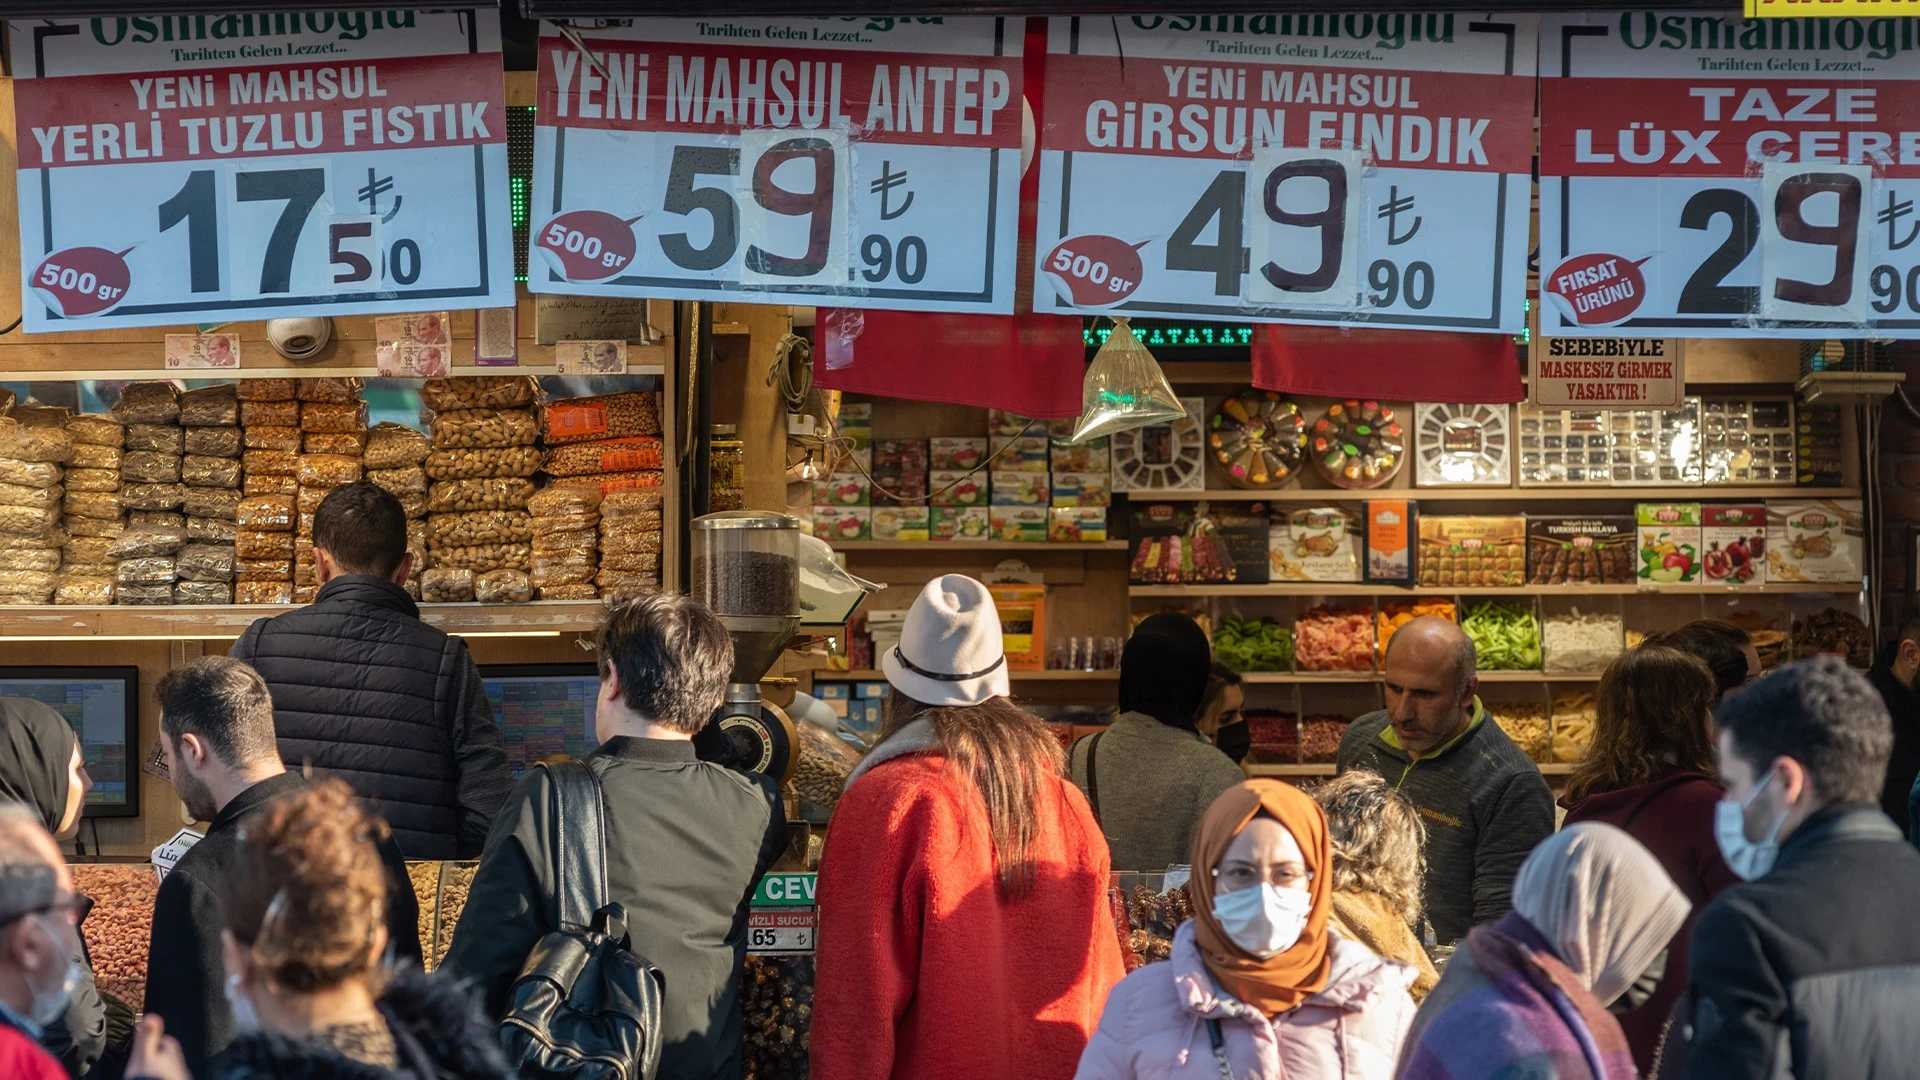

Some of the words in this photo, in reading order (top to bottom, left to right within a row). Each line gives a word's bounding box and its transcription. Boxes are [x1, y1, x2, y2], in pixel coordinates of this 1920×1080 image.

[696, 23, 760, 38] Tarihten
[764, 25, 807, 40] Gelen
[812, 28, 872, 43] Lezzet...
[1206, 39, 1272, 56] Tarihten
[1275, 43, 1320, 58] Gelen
[1323, 46, 1383, 61] Lezzet...
[1619, 11, 1920, 59] Osmanlıoğl
[171, 46, 236, 62] Tarihten
[239, 44, 284, 59] Gelen
[286, 41, 347, 56] Lezzet...
[1698, 57, 1762, 71] Tarihten
[1767, 57, 1809, 71] Gelen
[1814, 58, 1875, 72] Lezzet...
[229, 66, 386, 105] MAHSUL
[666, 56, 850, 129] MAHSUL
[868, 64, 1009, 136] ANTEP
[1261, 70, 1419, 109] MAHSUL
[1689, 87, 1877, 122] TAZE
[32, 110, 163, 163] YERLİ
[180, 112, 323, 155] TUZLU
[344, 101, 491, 146] FISTIK
[1308, 111, 1490, 165] FINDIK
[1575, 122, 1721, 164] LÜX
[658, 137, 835, 277] 59
[158, 168, 326, 293] 17
[1165, 158, 1347, 296] 49
[1677, 172, 1862, 314] 29
[1557, 259, 1618, 294] FIRSAT
[1575, 277, 1635, 313] ÜRÜNÜ
[168, 357, 179, 366] 10
[1566, 383, 1639, 400] YASAKTIR
[1548, 526, 1580, 534] TURKISH
[1582, 526, 1618, 534] BAKLAVA
[765, 877, 817, 900] CEV
[777, 916, 814, 926] SUCUK
